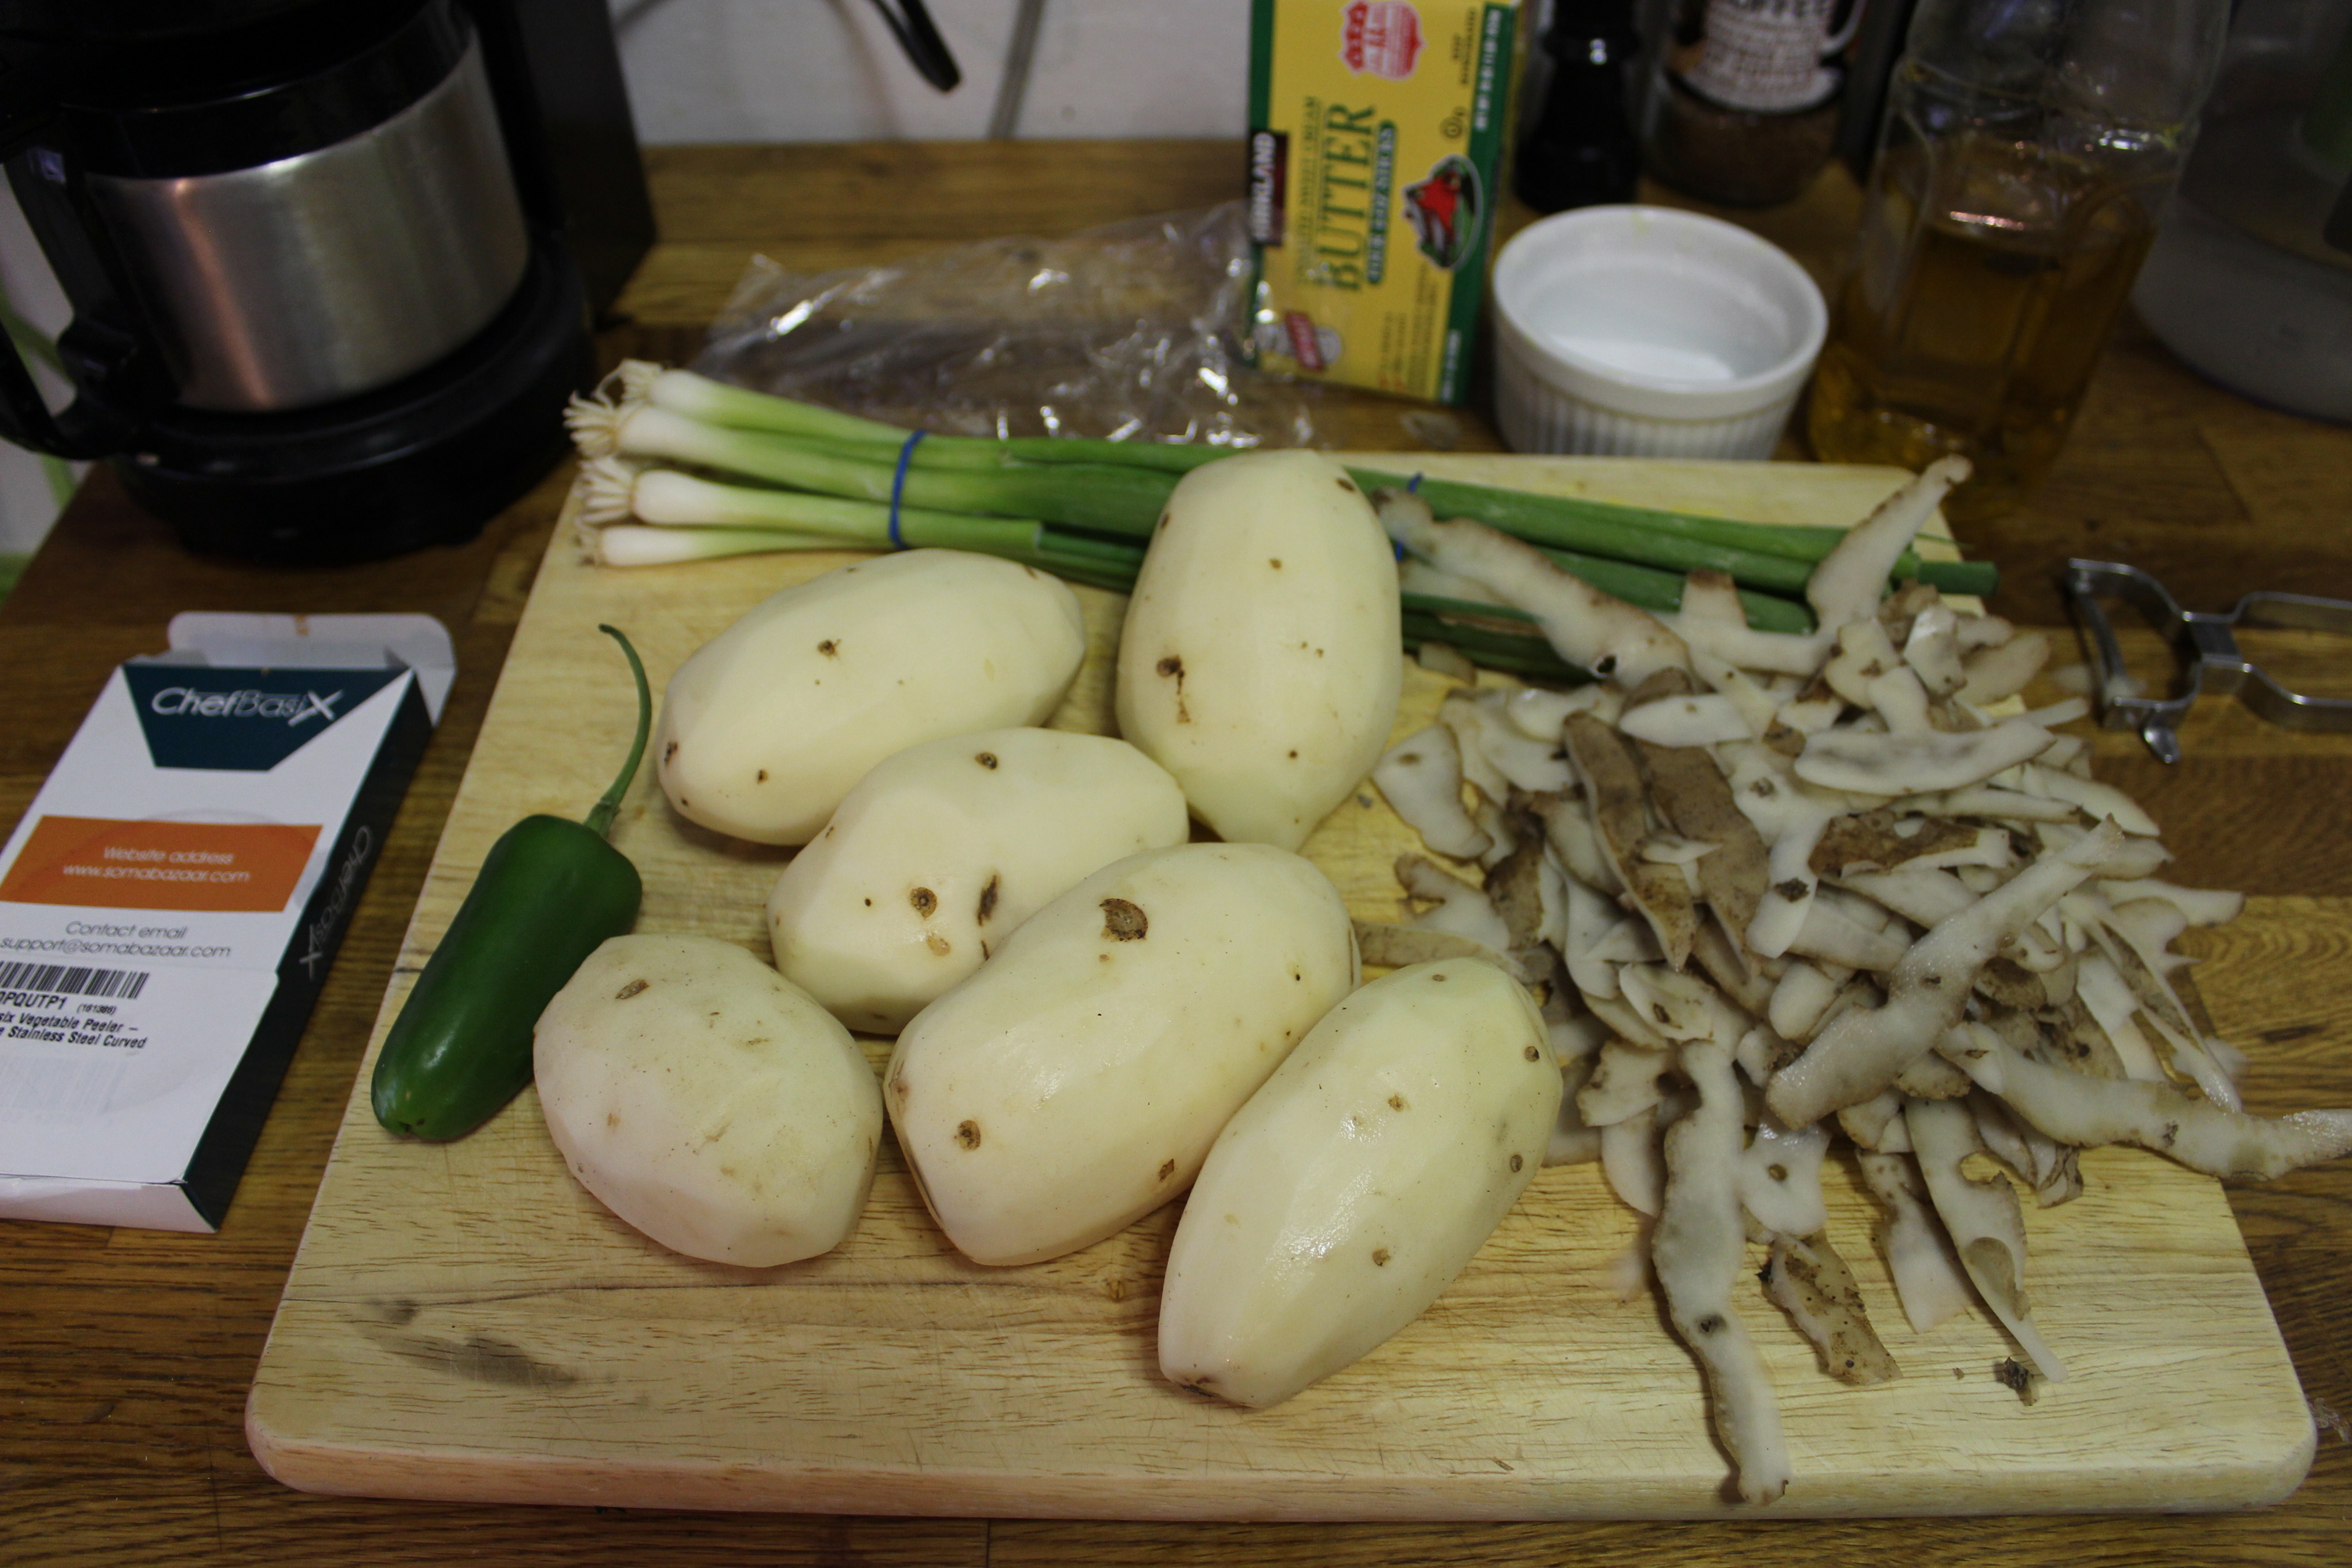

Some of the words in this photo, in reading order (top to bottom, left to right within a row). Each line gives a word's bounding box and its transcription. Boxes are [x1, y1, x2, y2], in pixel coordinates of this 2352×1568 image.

[1250, 132, 1276, 240] KIRKLAND
[1316, 102, 1376, 291] BUTTER
[104, 847, 166, 862] Website
[169, 851, 234, 864] address
[63, 864, 250, 882] www.somabazaar.com
[65, 921, 136, 936] Contact
[138, 926, 188, 939] email
[0, 937, 231, 958] support@somabazaar.com
[19, 1013, 79, 1029] Vegetable
[82, 1019, 124, 1032] Peeler
[8, 1026, 65, 1042] Stainless
[68, 1031, 102, 1045] Steel
[103, 1034, 147, 1049] Curved
